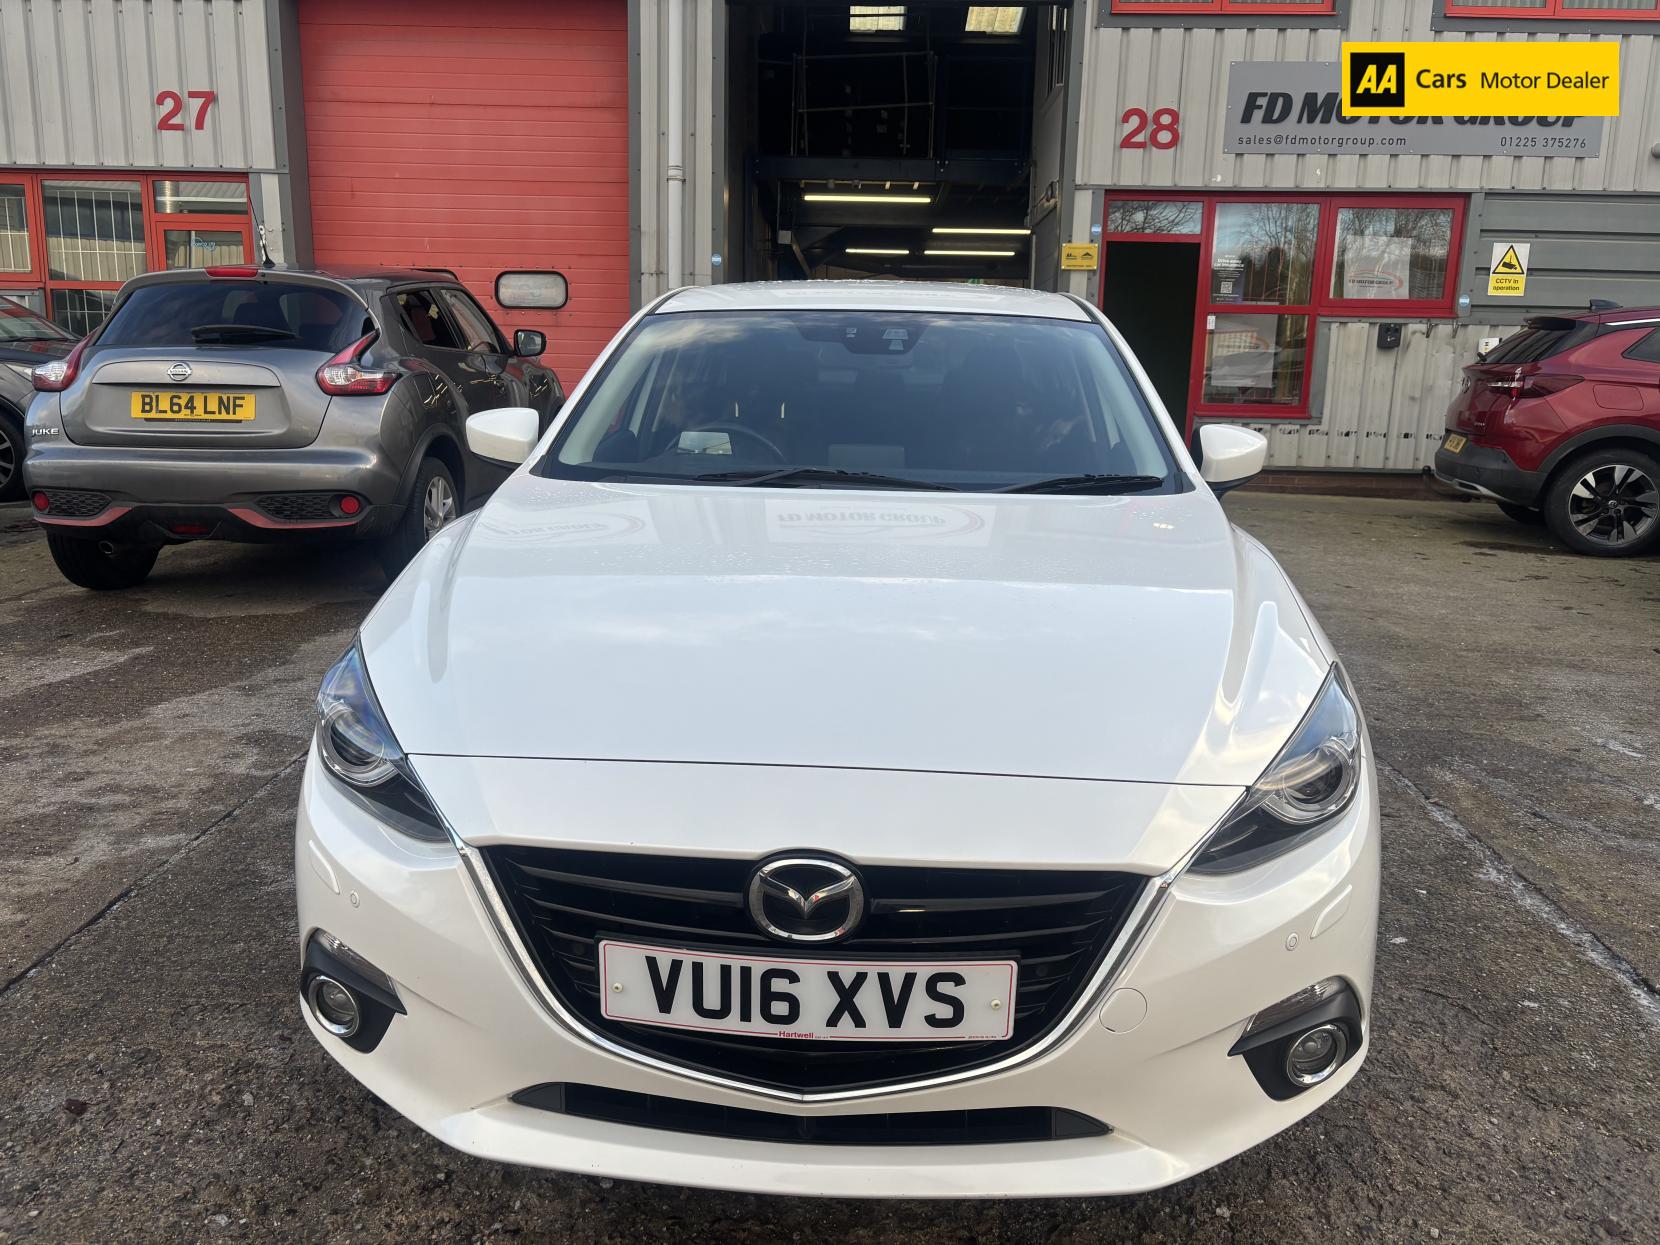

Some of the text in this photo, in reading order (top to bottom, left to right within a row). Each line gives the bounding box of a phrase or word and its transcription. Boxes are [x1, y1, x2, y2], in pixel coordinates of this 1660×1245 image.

[156, 91, 214, 130] 27
[1240, 92, 1293, 124] FD
[1120, 108, 1179, 149] 28
[1238, 134, 1407, 148] sales@fdmotorgroup.com
[1500, 136, 1586, 149] 01225 375276
[140, 394, 246, 416] BL64 LNF
[32, 428, 59, 436] JUKE
[644, 956, 967, 1029] VU16 XVS
[779, 1031, 814, 1039] Hartwell
